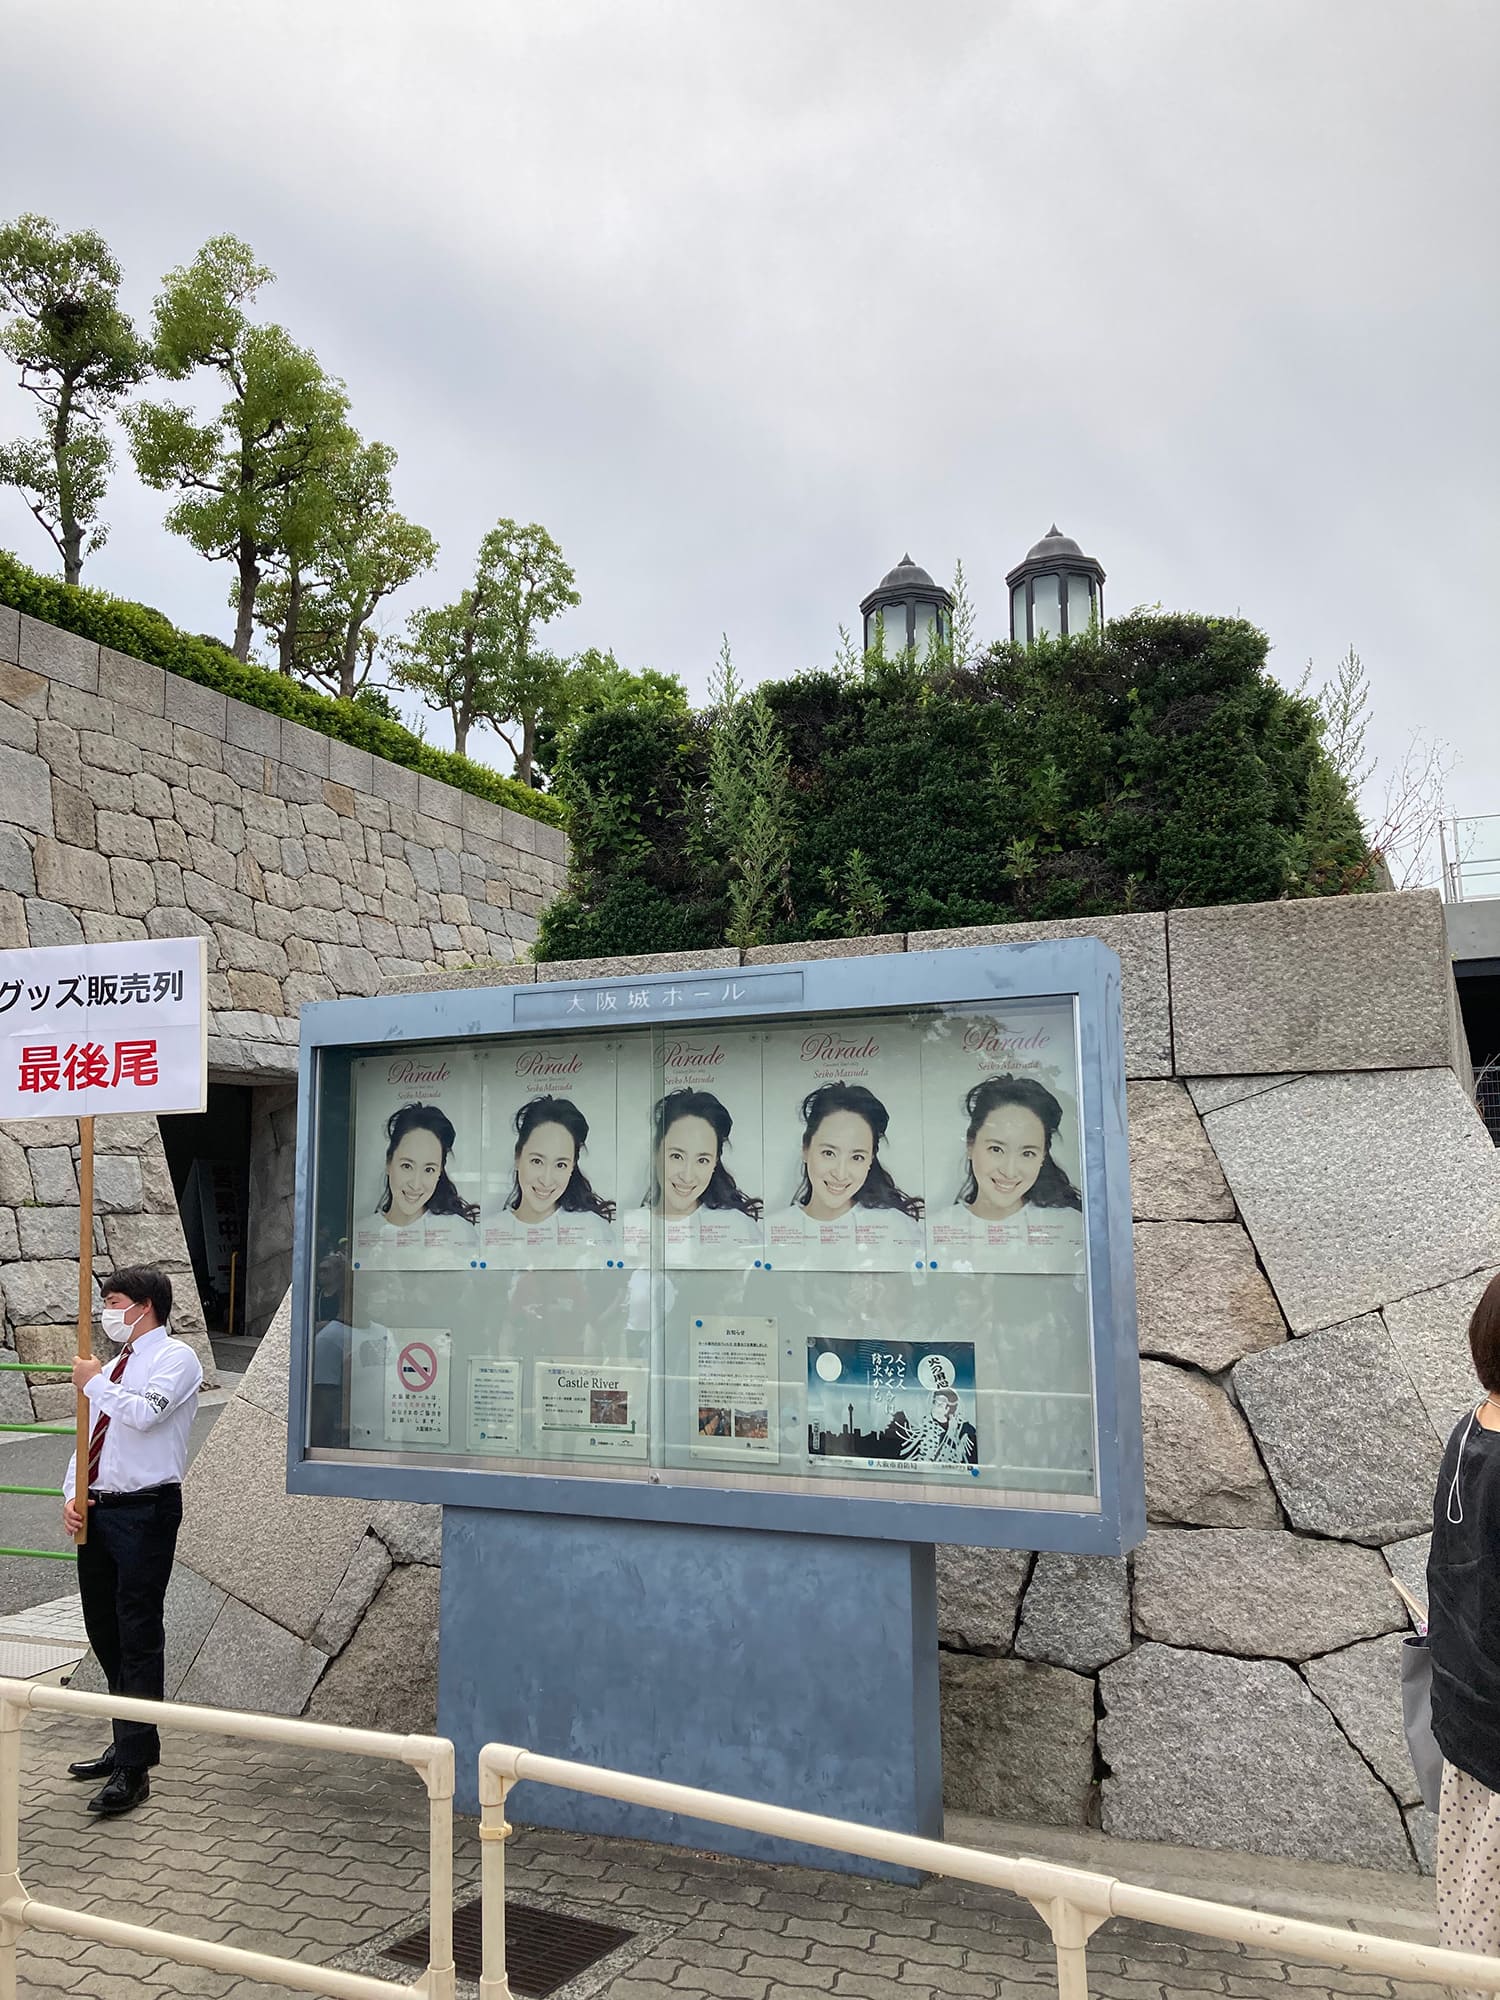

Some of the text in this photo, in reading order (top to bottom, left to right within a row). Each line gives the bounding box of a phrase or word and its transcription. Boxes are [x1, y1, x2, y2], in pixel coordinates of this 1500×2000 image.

[0, 969, 184, 1013] グッズ販売列
[566, 983, 746, 1014] 大阪城ホール
[800, 1032, 880, 1062] Parade
[962, 1023, 1051, 1053] Parade
[18, 1039, 159, 1093] 最後尾
[515, 1050, 584, 1078] Parade
[654, 1040, 725, 1070] Parade
[387, 1058, 450, 1085] Parade
[557, 1376, 620, 1390] Castle River
[928, 1356, 949, 1389] 火の用心
